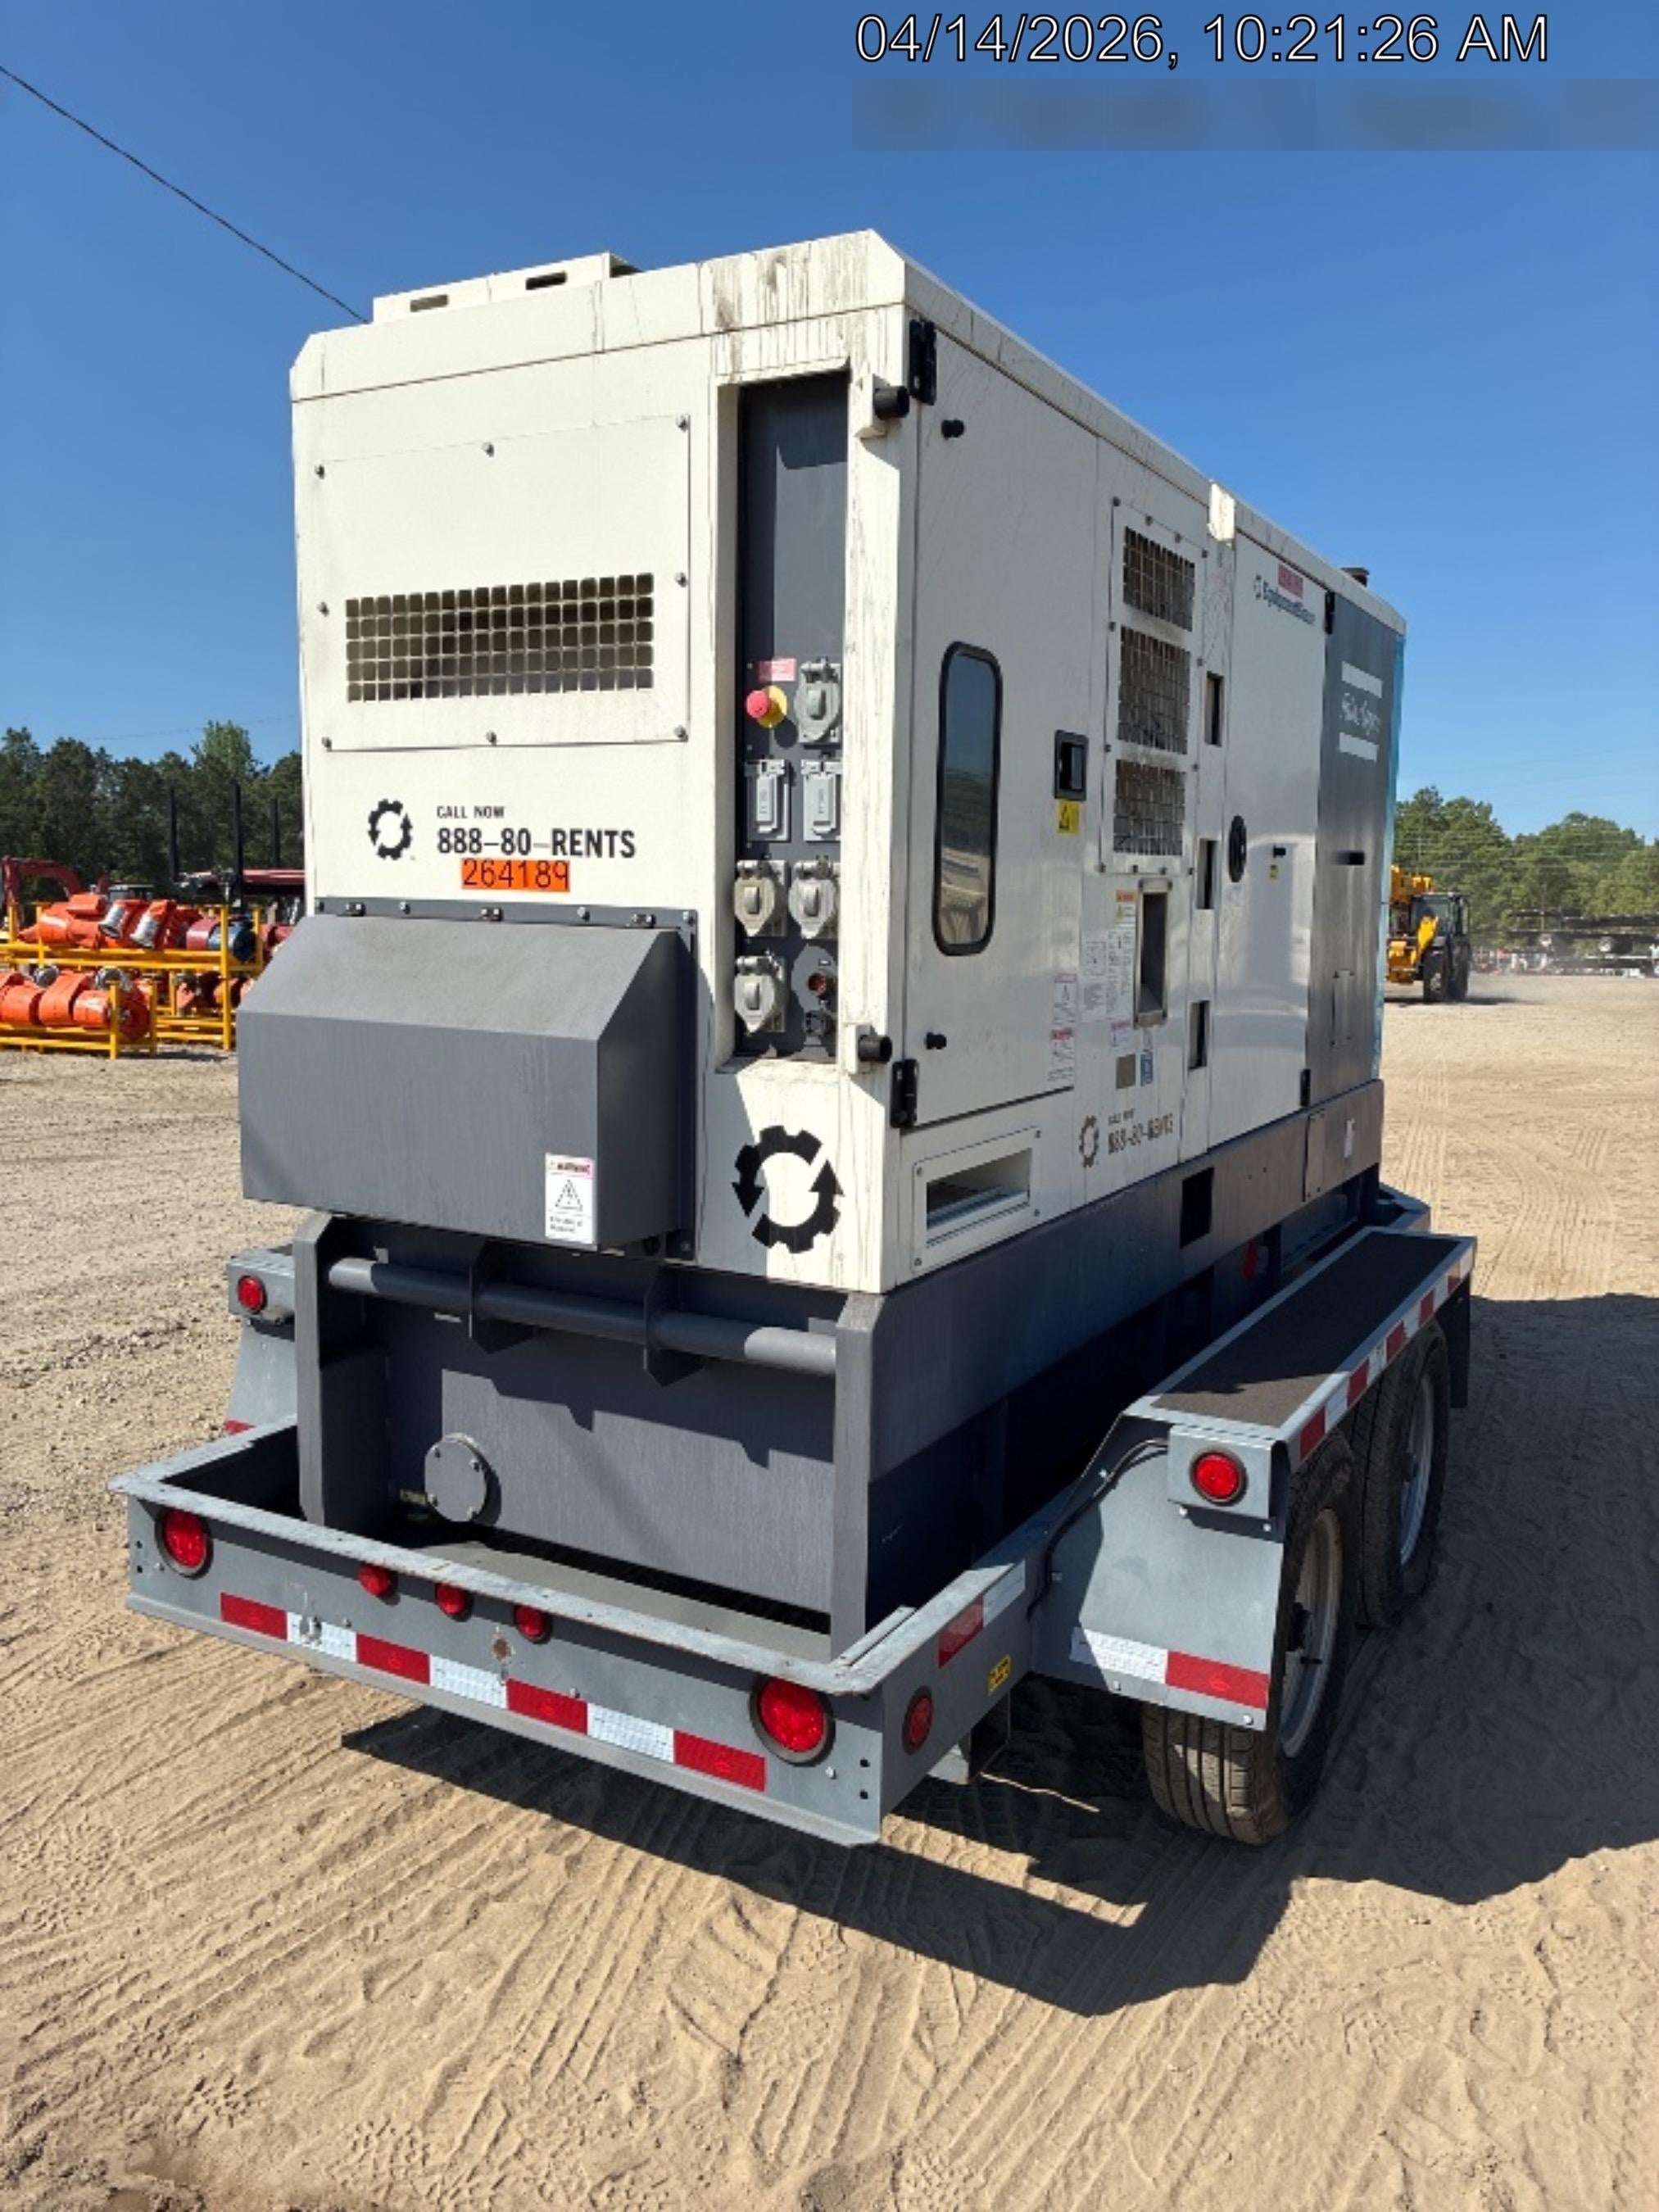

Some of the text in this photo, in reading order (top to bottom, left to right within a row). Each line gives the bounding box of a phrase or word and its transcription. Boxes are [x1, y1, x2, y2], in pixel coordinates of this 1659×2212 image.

[436, 805, 505, 819] CALL NOW
[437, 827, 637, 859] 888-80-RENTS
[463, 859, 570, 890] 264189
